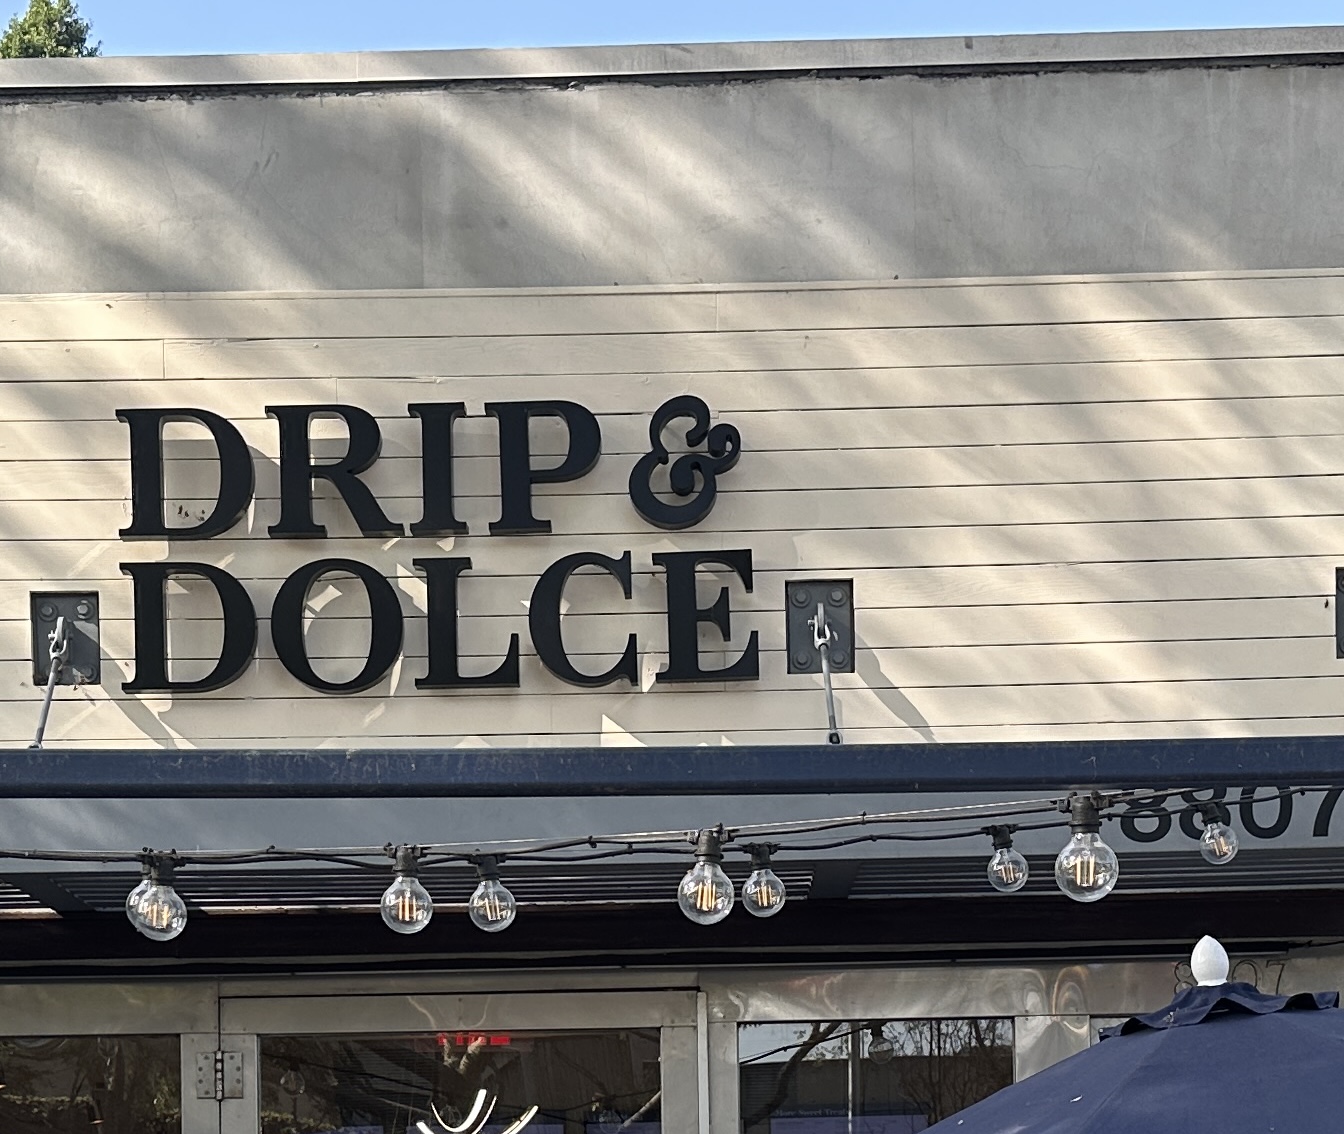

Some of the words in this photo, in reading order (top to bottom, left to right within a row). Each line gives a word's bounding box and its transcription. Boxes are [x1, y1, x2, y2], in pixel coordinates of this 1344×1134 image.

[115, 399, 603, 540] DRIP
[628, 395, 742, 530] &
[118, 548, 760, 695] DOLCE
[1173, 959, 1287, 996] 807
